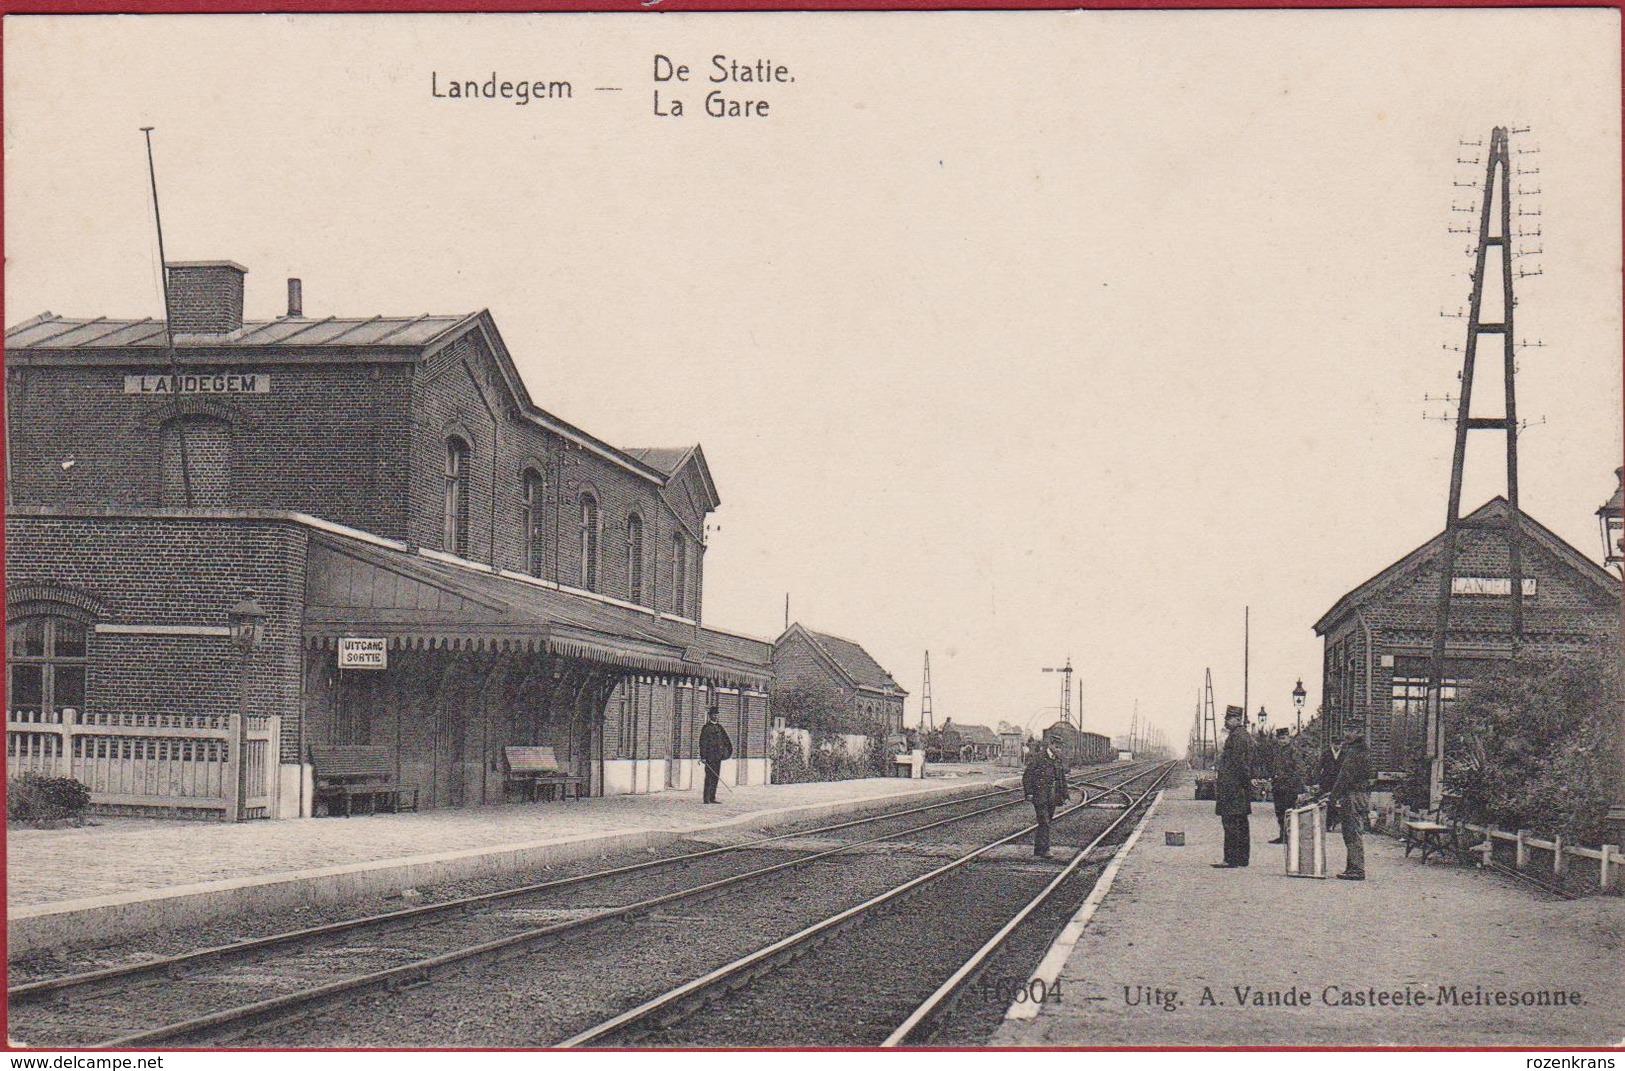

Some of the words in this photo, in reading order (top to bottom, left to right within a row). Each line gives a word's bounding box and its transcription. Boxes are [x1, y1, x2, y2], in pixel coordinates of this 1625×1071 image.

[654, 54, 690, 82] De
[709, 54, 796, 83] Statie.
[432, 71, 572, 106] Landegem
[654, 90, 684, 117] La
[705, 90, 770, 117] Gare
[140, 375, 256, 392] LANDEGEM
[346, 652, 381, 662] SORTIE
[1123, 986, 1184, 1012] Uitg.
[1200, 986, 1224, 1006] A.
[1234, 985, 1311, 1007] Vande
